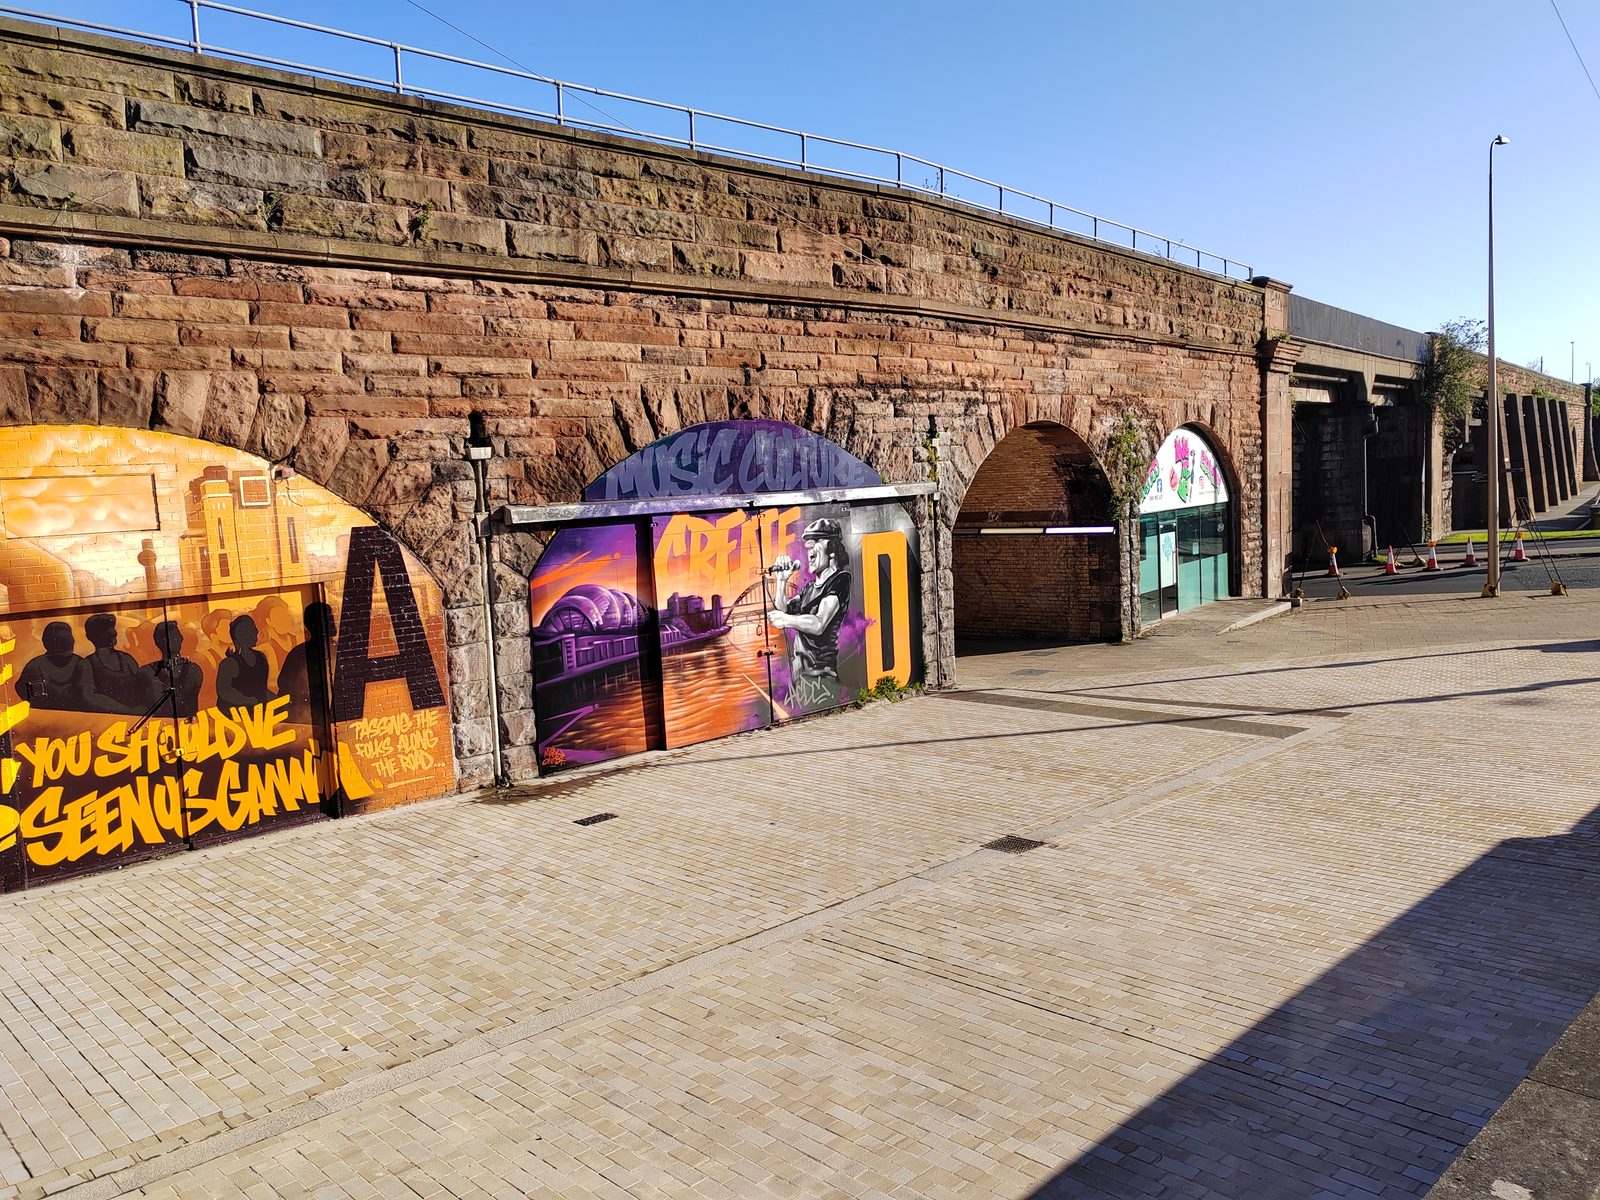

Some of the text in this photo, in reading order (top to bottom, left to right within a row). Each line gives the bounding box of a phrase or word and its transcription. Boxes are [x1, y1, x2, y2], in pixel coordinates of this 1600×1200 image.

[738, 428, 865, 494] CULTURE
[653, 506, 801, 582] CREATE
[355, 729, 439, 760] FOLKS ALONG
[413, 710, 439, 729] THE
[16, 731, 91, 788] YOU
[371, 757, 400, 777] THE
[20, 778, 166, 866] SEEN
[154, 768, 218, 838] US
